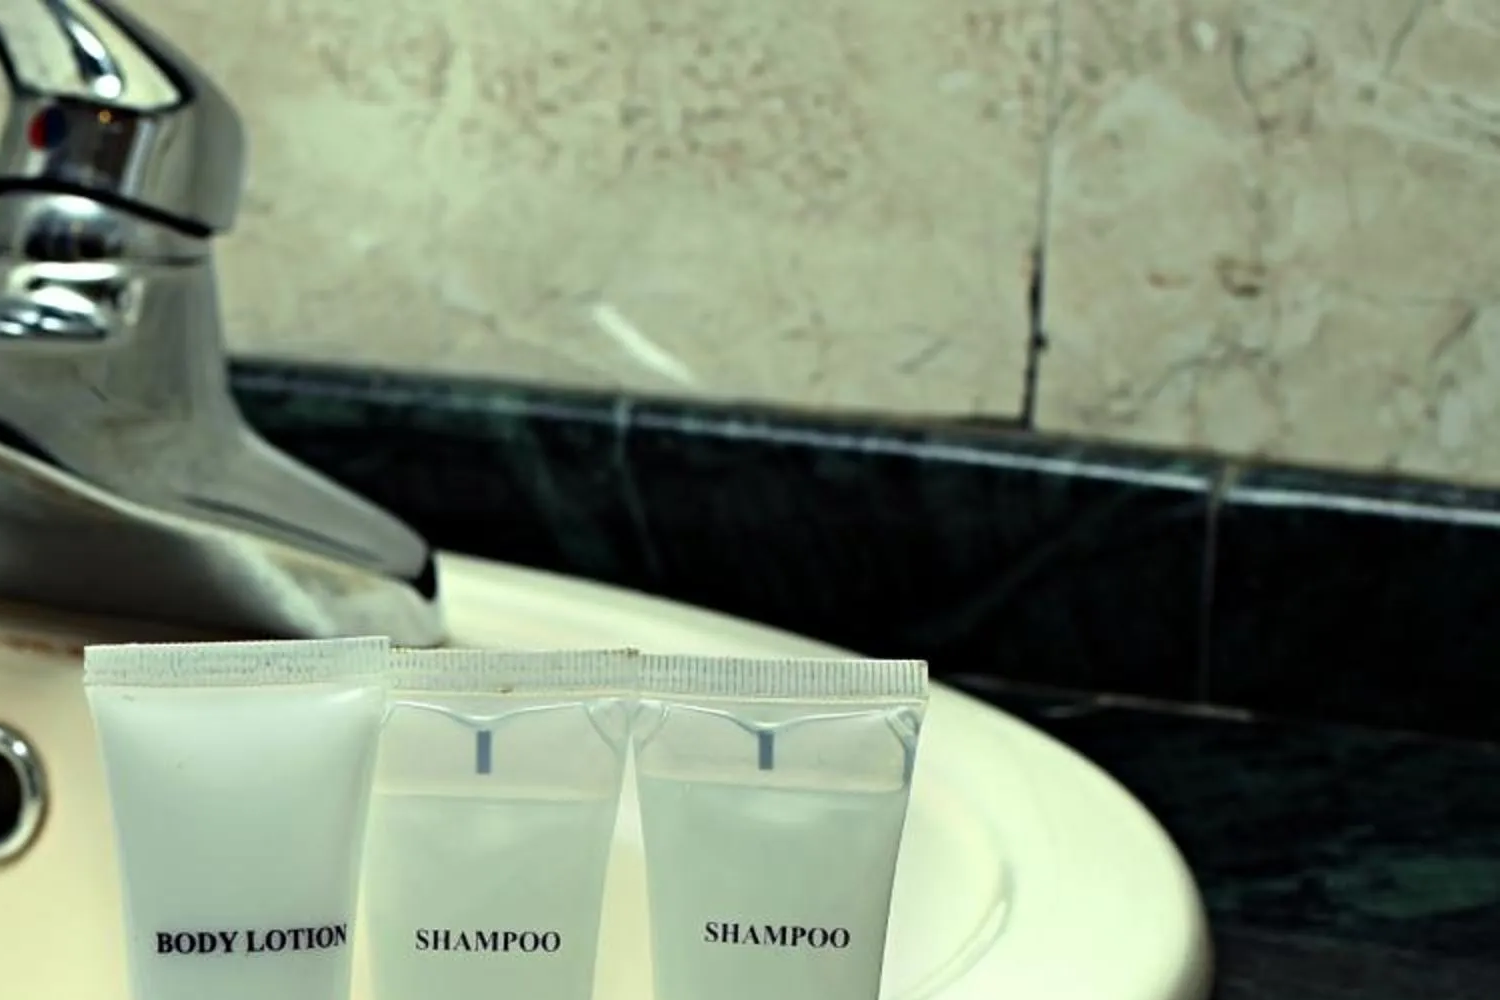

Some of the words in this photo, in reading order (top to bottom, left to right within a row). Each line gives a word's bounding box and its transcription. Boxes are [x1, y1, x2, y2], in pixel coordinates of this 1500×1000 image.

[156, 931, 239, 954] BODY
[246, 923, 347, 952] LOTION
[415, 929, 561, 952] SHAMPOO
[704, 921, 851, 949] SHAMPOO
